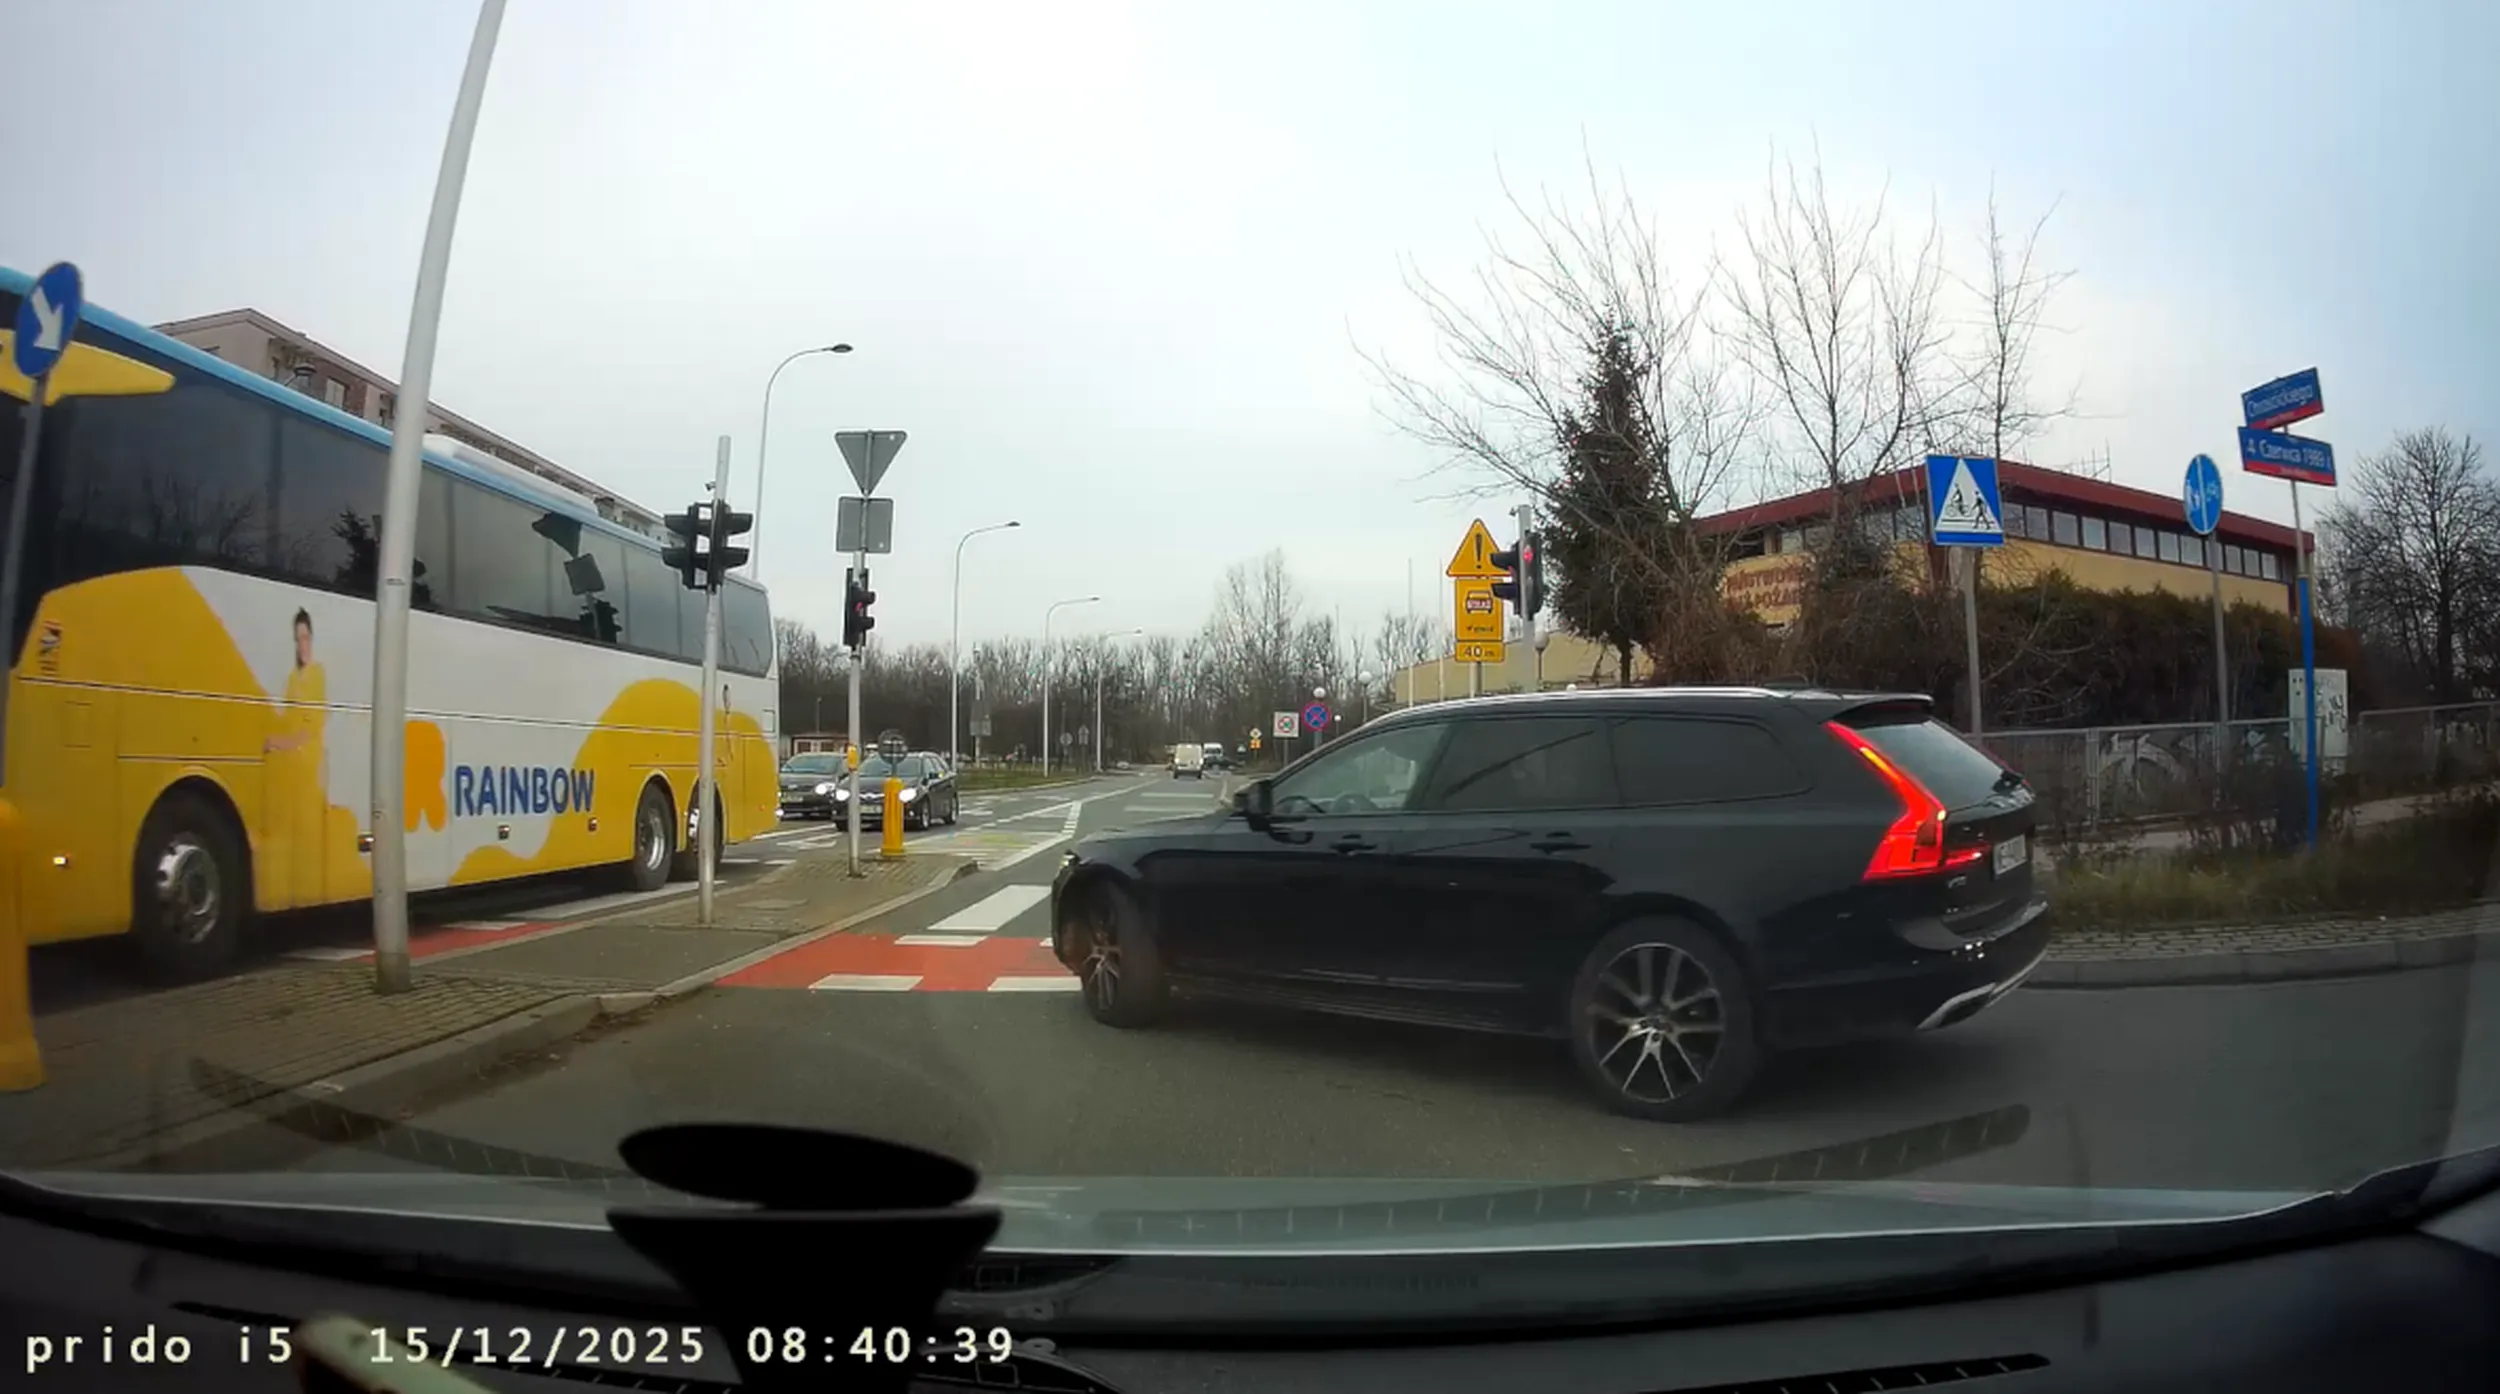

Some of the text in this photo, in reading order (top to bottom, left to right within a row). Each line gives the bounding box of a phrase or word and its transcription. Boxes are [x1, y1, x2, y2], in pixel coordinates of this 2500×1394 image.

[2247, 438, 2256, 456] 4
[1463, 645, 1483, 658] 40
[454, 765, 595, 817] RAINBOW
